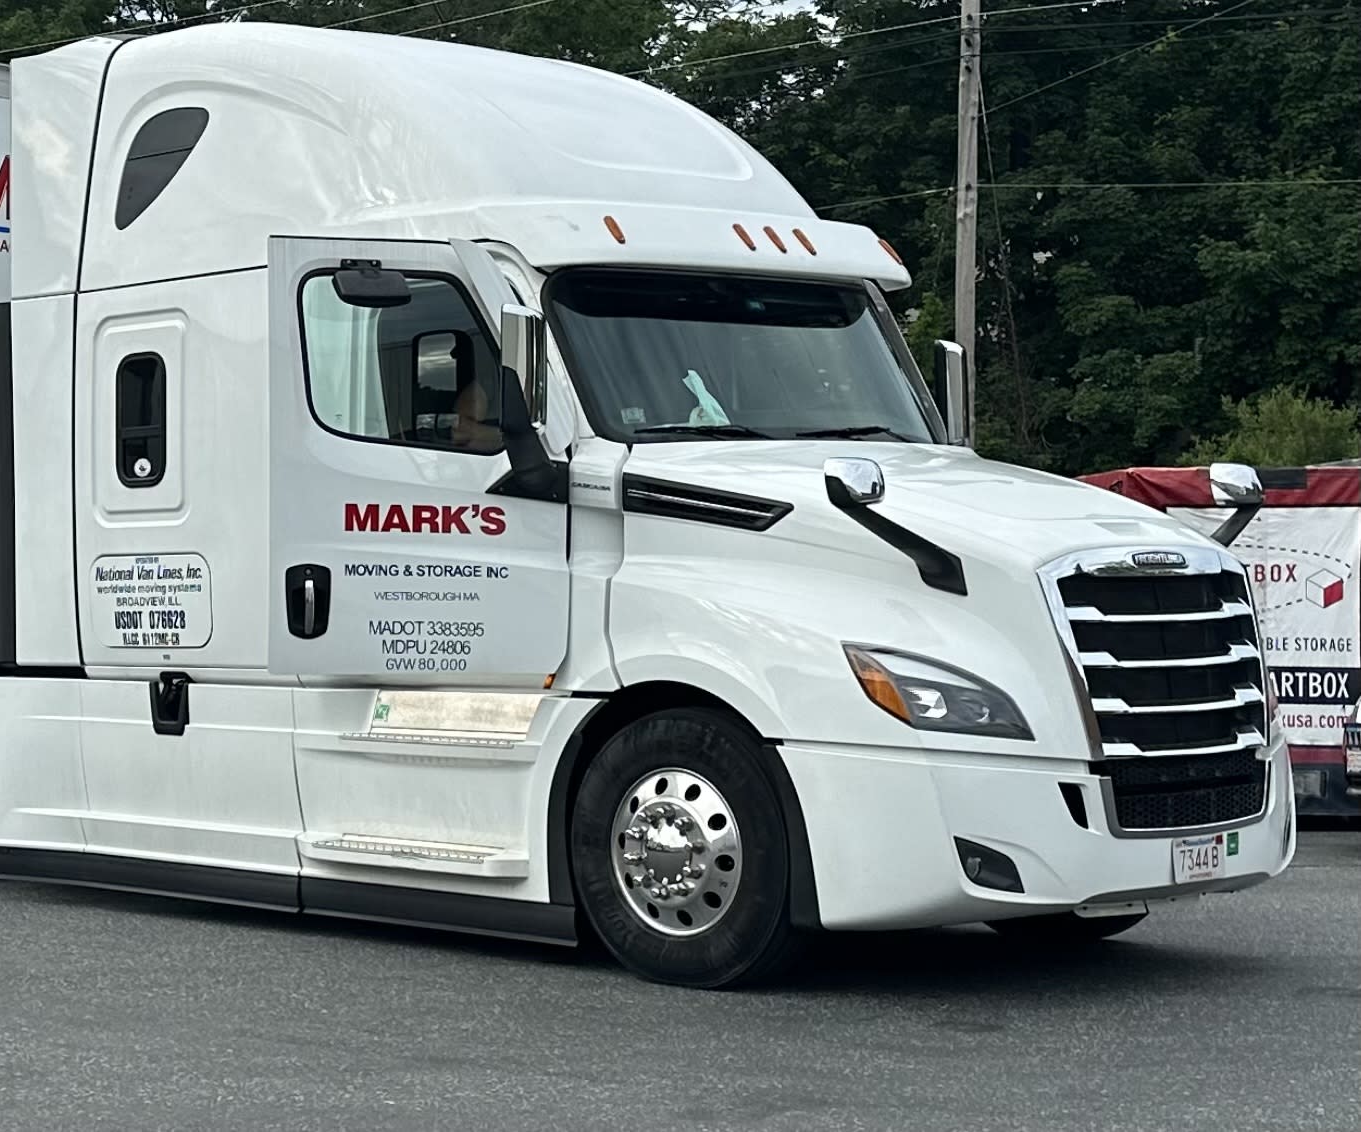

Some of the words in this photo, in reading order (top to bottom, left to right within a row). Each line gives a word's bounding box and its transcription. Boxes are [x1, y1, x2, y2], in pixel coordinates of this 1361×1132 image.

[344, 503, 506, 536] MARK'S
[95, 566, 134, 581] National
[137, 565, 154, 580] Van
[344, 564, 399, 577] MOVING
[403, 564, 413, 577] &
[416, 565, 482, 578] STORAGE
[486, 566, 509, 579] INC
[1245, 564, 1297, 582] BOX
[138, 583, 166, 595] moving
[374, 591, 461, 601] WESTBOROUGH
[463, 592, 480, 601] MA
[114, 611, 142, 629] USDOT
[149, 610, 186, 629] 076628
[369, 620, 424, 636] MADOT
[427, 621, 484, 637] 3383595
[382, 640, 427, 654] MDPU
[430, 640, 471, 655] 24806
[1262, 637, 1289, 651] BLE
[1295, 637, 1352, 652] STORAGE
[386, 658, 416, 670] GVW
[418, 658, 467, 672] 80,000
